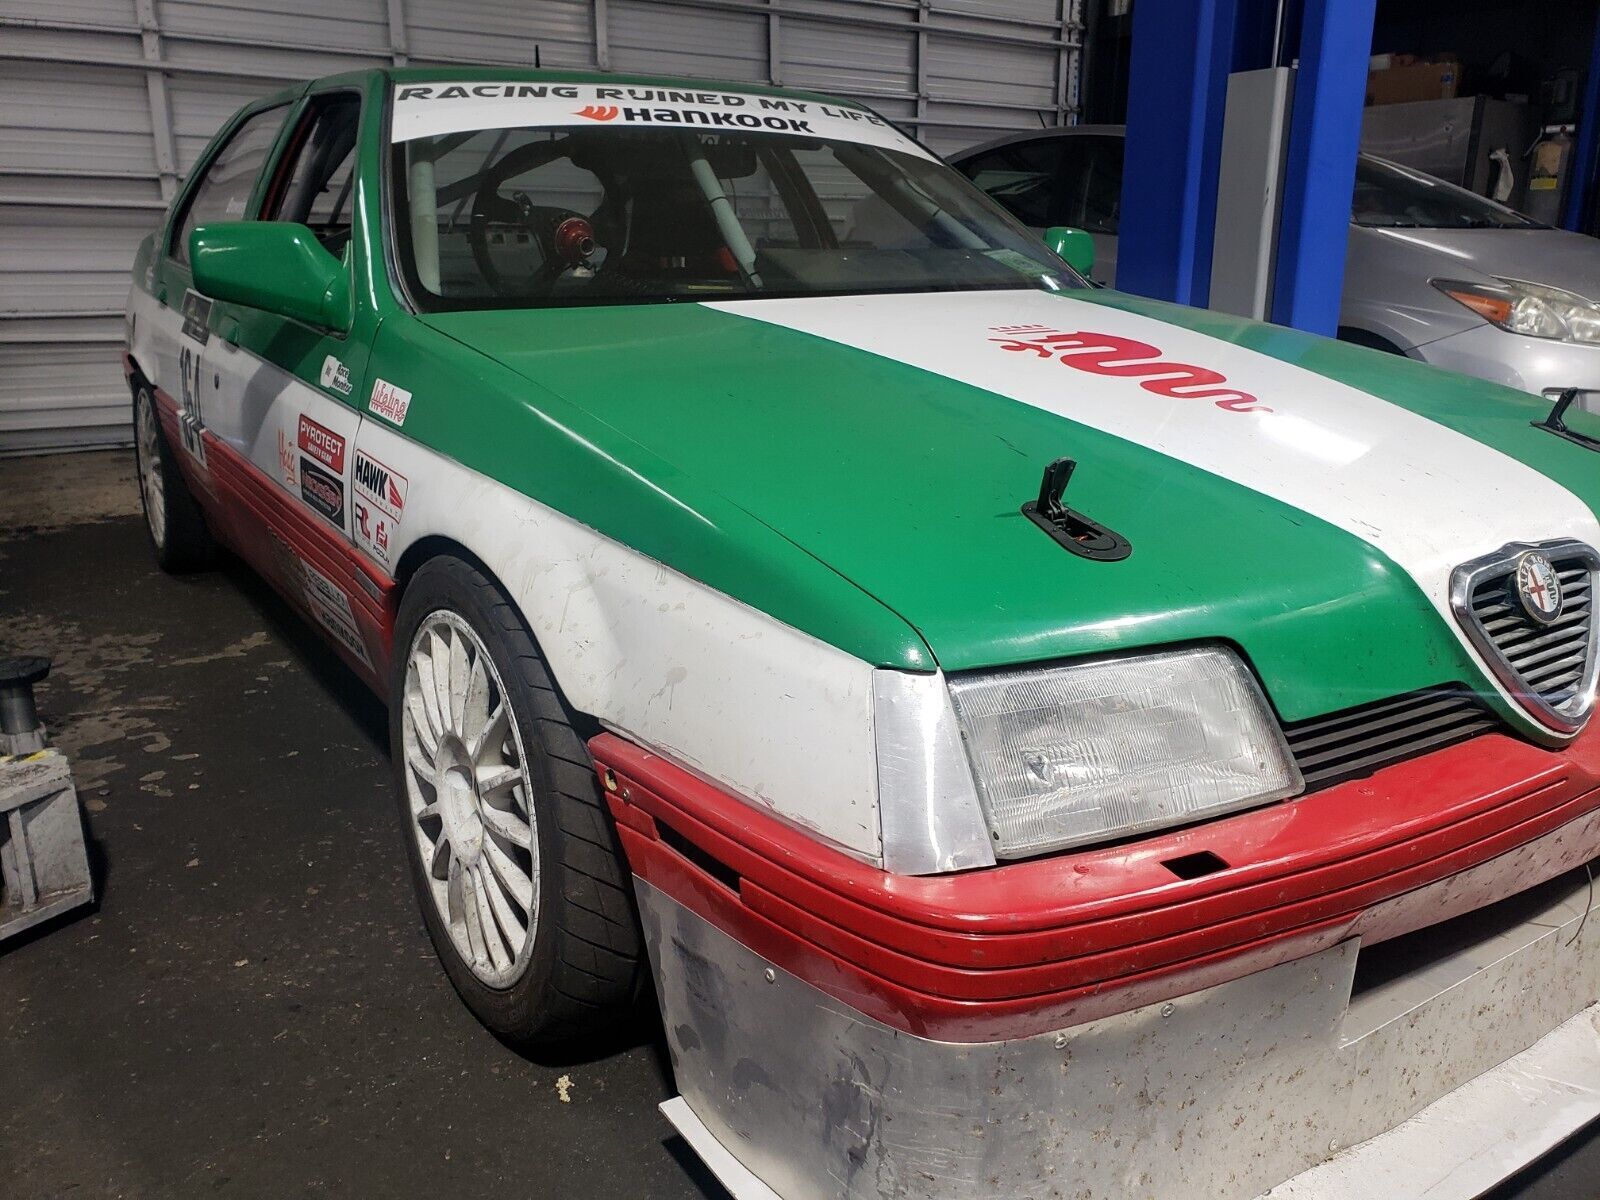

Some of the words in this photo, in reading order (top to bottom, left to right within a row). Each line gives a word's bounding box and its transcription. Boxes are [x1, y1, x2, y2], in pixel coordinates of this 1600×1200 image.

[398, 85, 578, 101] RACING
[596, 88, 746, 107] RUINED
[761, 99, 808, 113] MY
[820, 106, 886, 128] LIFE
[300, 421, 342, 457] PYROTECT
[355, 454, 389, 501] HAWK
